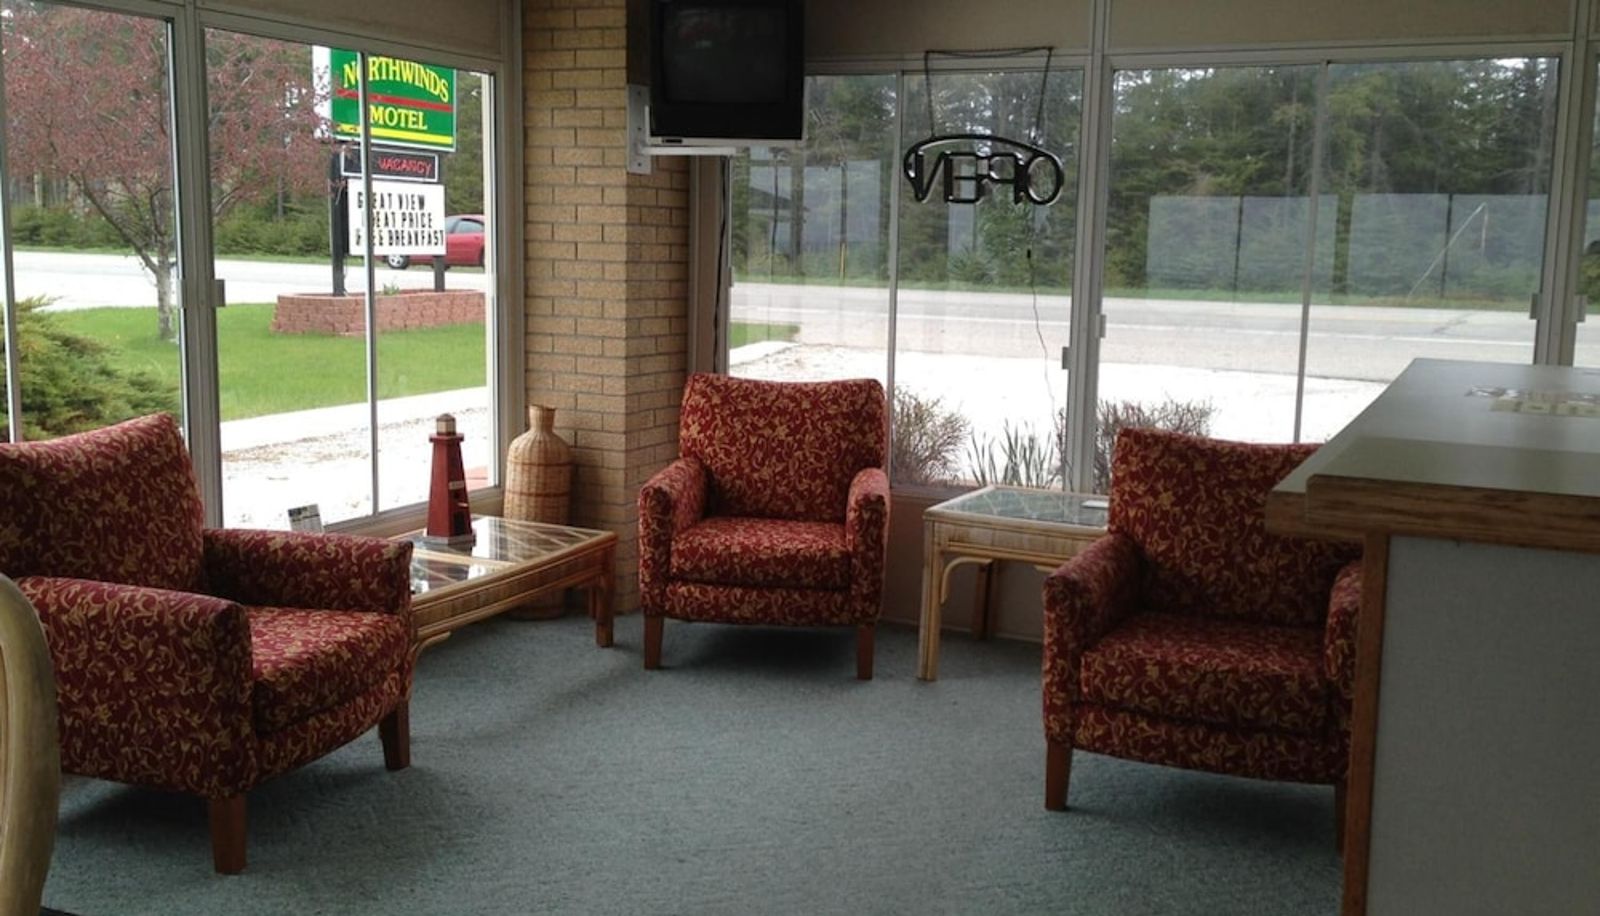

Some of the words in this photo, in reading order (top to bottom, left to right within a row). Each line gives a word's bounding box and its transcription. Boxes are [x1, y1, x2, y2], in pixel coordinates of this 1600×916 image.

[343, 56, 449, 103] NRTHWINDS
[369, 104, 428, 131] MOTEL
[378, 156, 432, 175] VACANCY
[357, 191, 393, 210] GEAT
[397, 193, 425, 211] VIEW
[401, 211, 432, 229] PRICE
[388, 229, 444, 247] BREAKFAST
